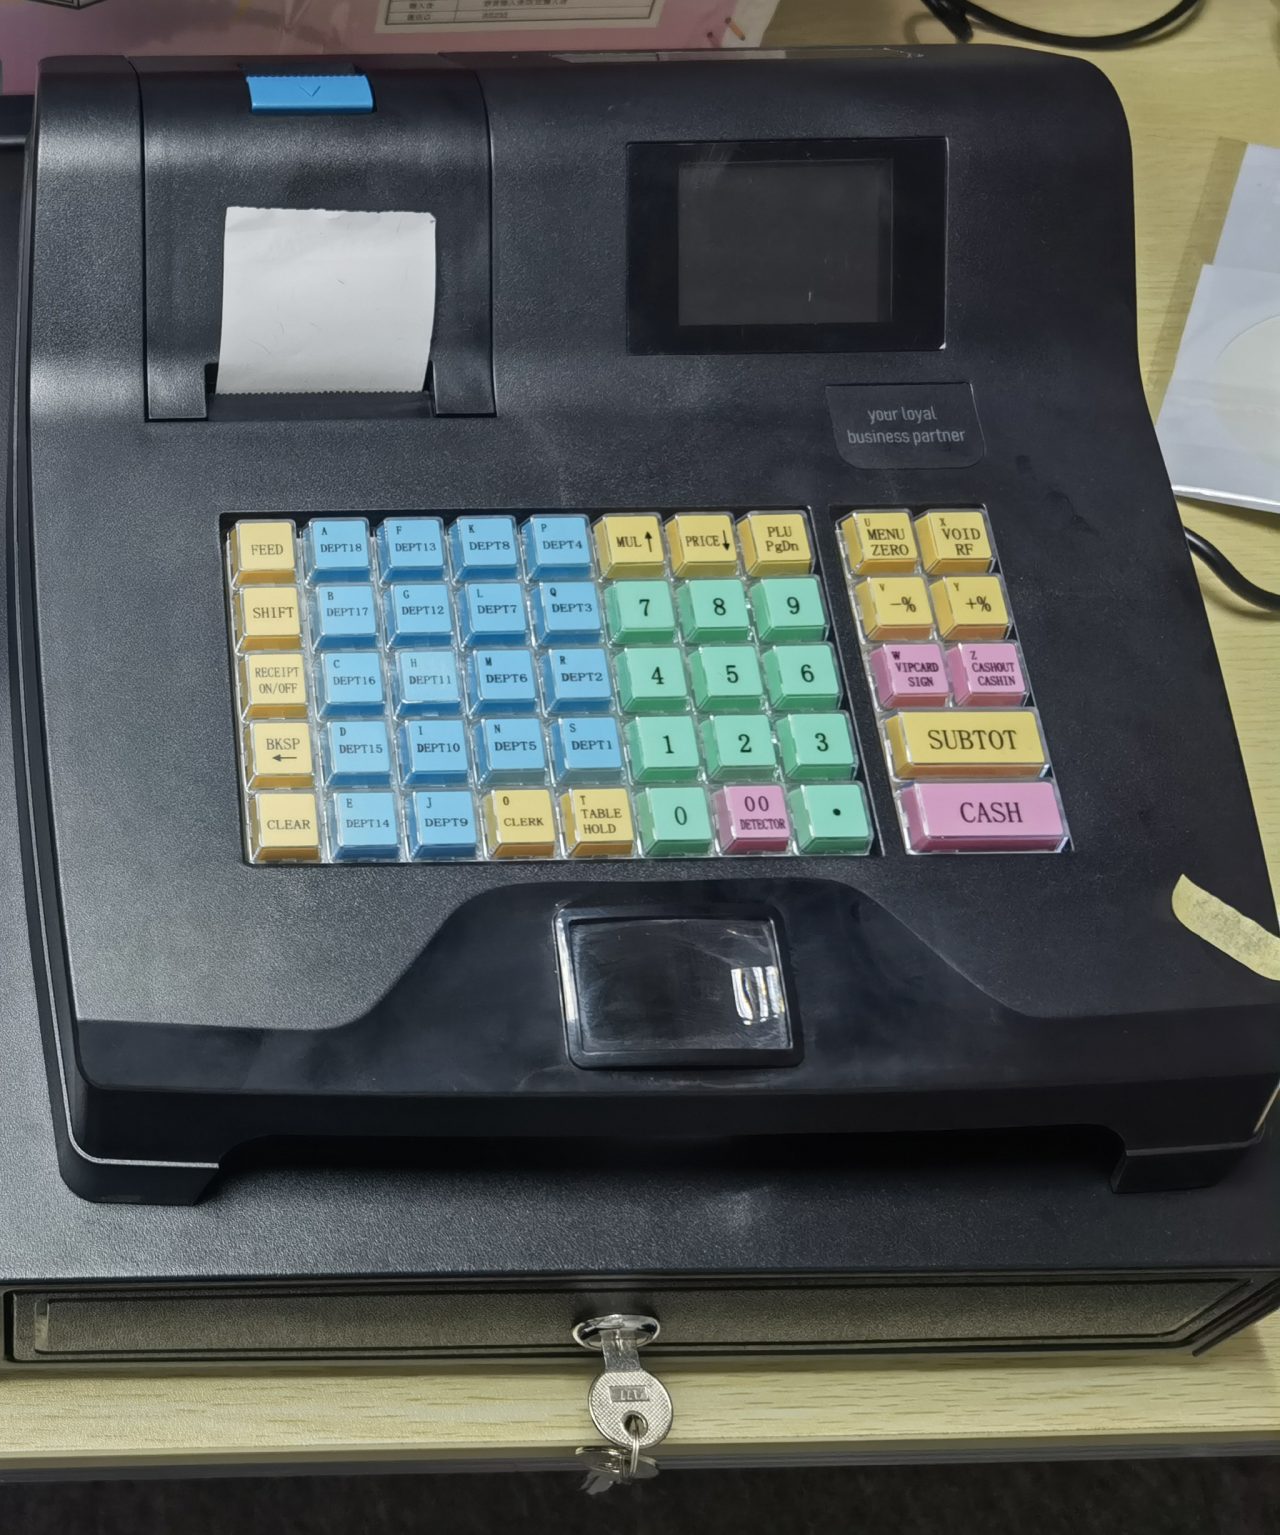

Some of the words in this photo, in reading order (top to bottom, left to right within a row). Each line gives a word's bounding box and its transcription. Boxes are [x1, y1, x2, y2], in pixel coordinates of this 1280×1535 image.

[867, 408, 897, 425] your
[900, 405, 938, 424] loyal
[846, 429, 910, 445] business
[912, 428, 966, 447] partner
[468, 524, 476, 534] K
[540, 523, 548, 533] P
[938, 517, 946, 528] X
[321, 525, 329, 537] A
[395, 525, 403, 536] F
[767, 525, 793, 539] PLU
[866, 528, 906, 542] MENU
[941, 527, 981, 541] VOID
[394, 541, 437, 553] DEPT13
[468, 540, 511, 552] DEPT8
[541, 539, 584, 551] DEPT4
[615, 535, 643, 549] MUL
[684, 534, 721, 548] PRICE
[765, 539, 800, 555] PgDn
[250, 543, 284, 557] FEED
[320, 542, 363, 554] DEPT18
[871, 543, 910, 557] ZERO
[954, 542, 974, 557] RF
[327, 591, 335, 601] B
[402, 589, 410, 600] G
[476, 588, 484, 599] L
[549, 587, 558, 598] Q
[326, 606, 369, 618] DEPT17
[401, 605, 445, 616] DEPT12
[476, 603, 518, 616] DEPT7
[551, 602, 593, 614] DEPT3
[638, 598, 651, 618] 7
[712, 597, 727, 616] 8
[786, 596, 800, 615] 9
[252, 606, 295, 620] SHIFT
[485, 656, 494, 667] M
[559, 655, 567, 666] R
[969, 650, 978, 661] Z
[332, 658, 341, 669] C
[409, 657, 418, 669] H
[894, 661, 940, 674] VIPCARD
[971, 661, 1015, 674] CASHOUT
[254, 666, 300, 679] RECEIPT
[485, 672, 529, 684] DEPT6
[560, 671, 604, 683] DEPT2
[650, 666, 665, 686] 4
[725, 665, 740, 684] 5
[800, 664, 815, 683] 6
[332, 674, 377, 687] DEPT16
[408, 673, 453, 686] DEPT11
[907, 675, 935, 688] SIGN
[977, 675, 1016, 687] CASHIN
[258, 682, 299, 695] ON/OFF
[339, 726, 347, 737] D
[494, 723, 502, 735] N
[568, 722, 576, 734] S
[265, 737, 301, 751] BKSP
[494, 740, 538, 752] DEPT5
[570, 739, 613, 751] DEPT1
[662, 735, 675, 755] 1
[738, 734, 753, 754] 2
[815, 732, 830, 752] 3
[927, 728, 1018, 751] SUBTOT
[338, 743, 384, 755] DEPT15
[416, 741, 461, 754] DEPT10
[345, 797, 354, 809] E
[426, 797, 433, 809] J
[579, 794, 587, 807] T
[743, 795, 770, 813] 00
[582, 807, 623, 820] TABLE
[674, 806, 688, 826] 0
[959, 801, 1024, 824] CASH
[266, 818, 311, 831] CLEAR
[345, 817, 390, 829] DEPT14
[424, 816, 469, 828] DEPT9
[503, 815, 545, 828] CLERK
[739, 817, 786, 831] DETECTOR
[582, 822, 617, 835] HOLD
